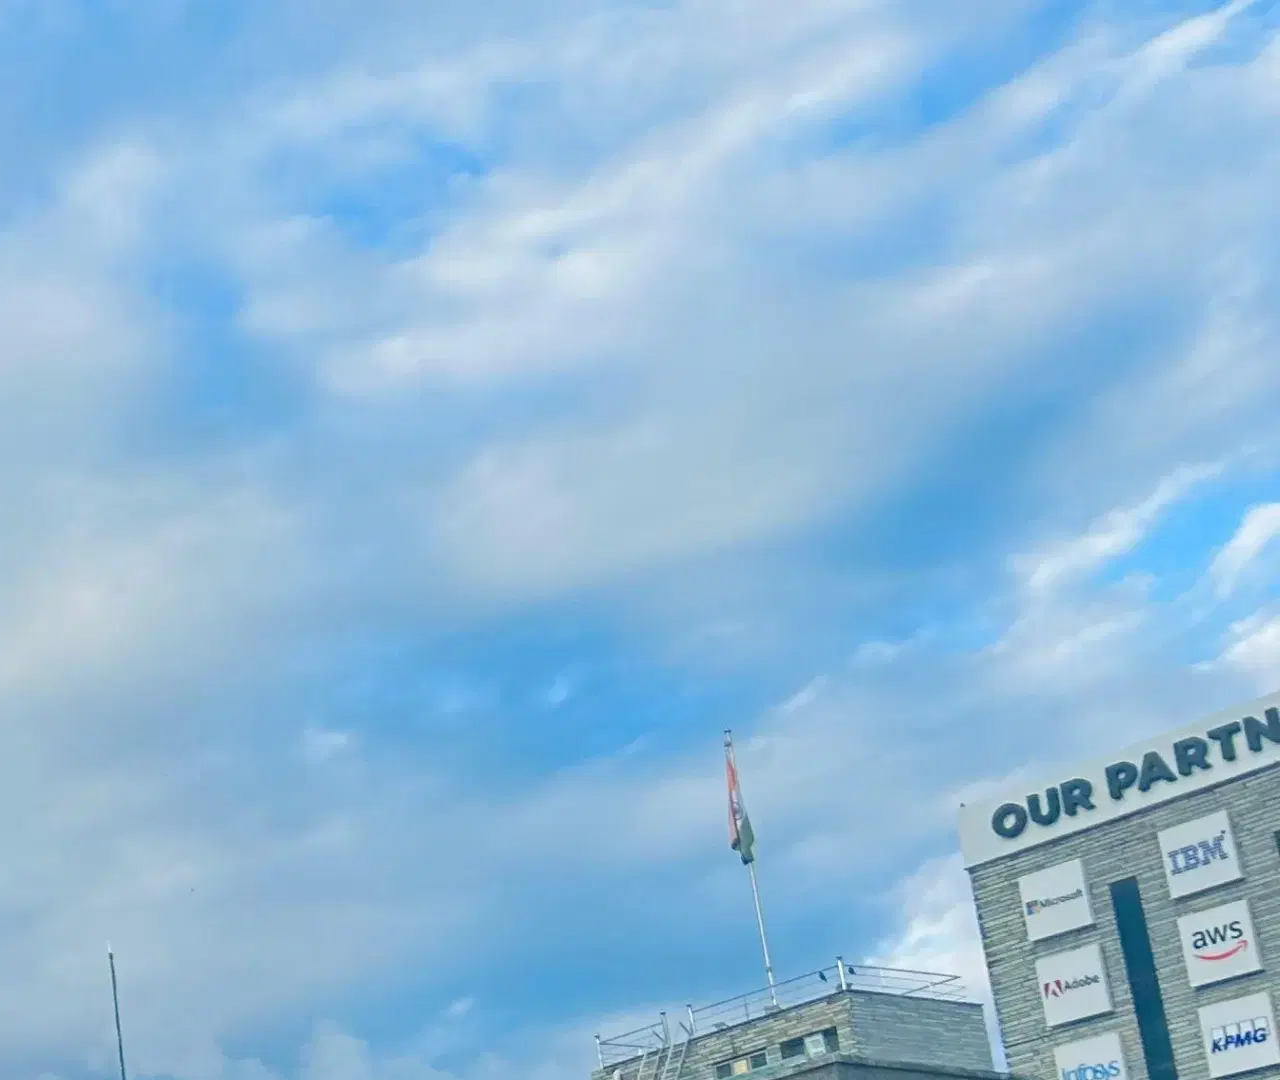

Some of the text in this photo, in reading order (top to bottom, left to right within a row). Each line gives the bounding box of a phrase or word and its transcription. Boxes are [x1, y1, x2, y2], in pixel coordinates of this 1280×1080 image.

[992, 706, 1280, 839] OUR PARTN
[1167, 834, 1229, 876] IBM
[1191, 920, 1243, 949] aws
[1064, 974, 1101, 990] Adobe
[1212, 1027, 1267, 1054] KPMG
